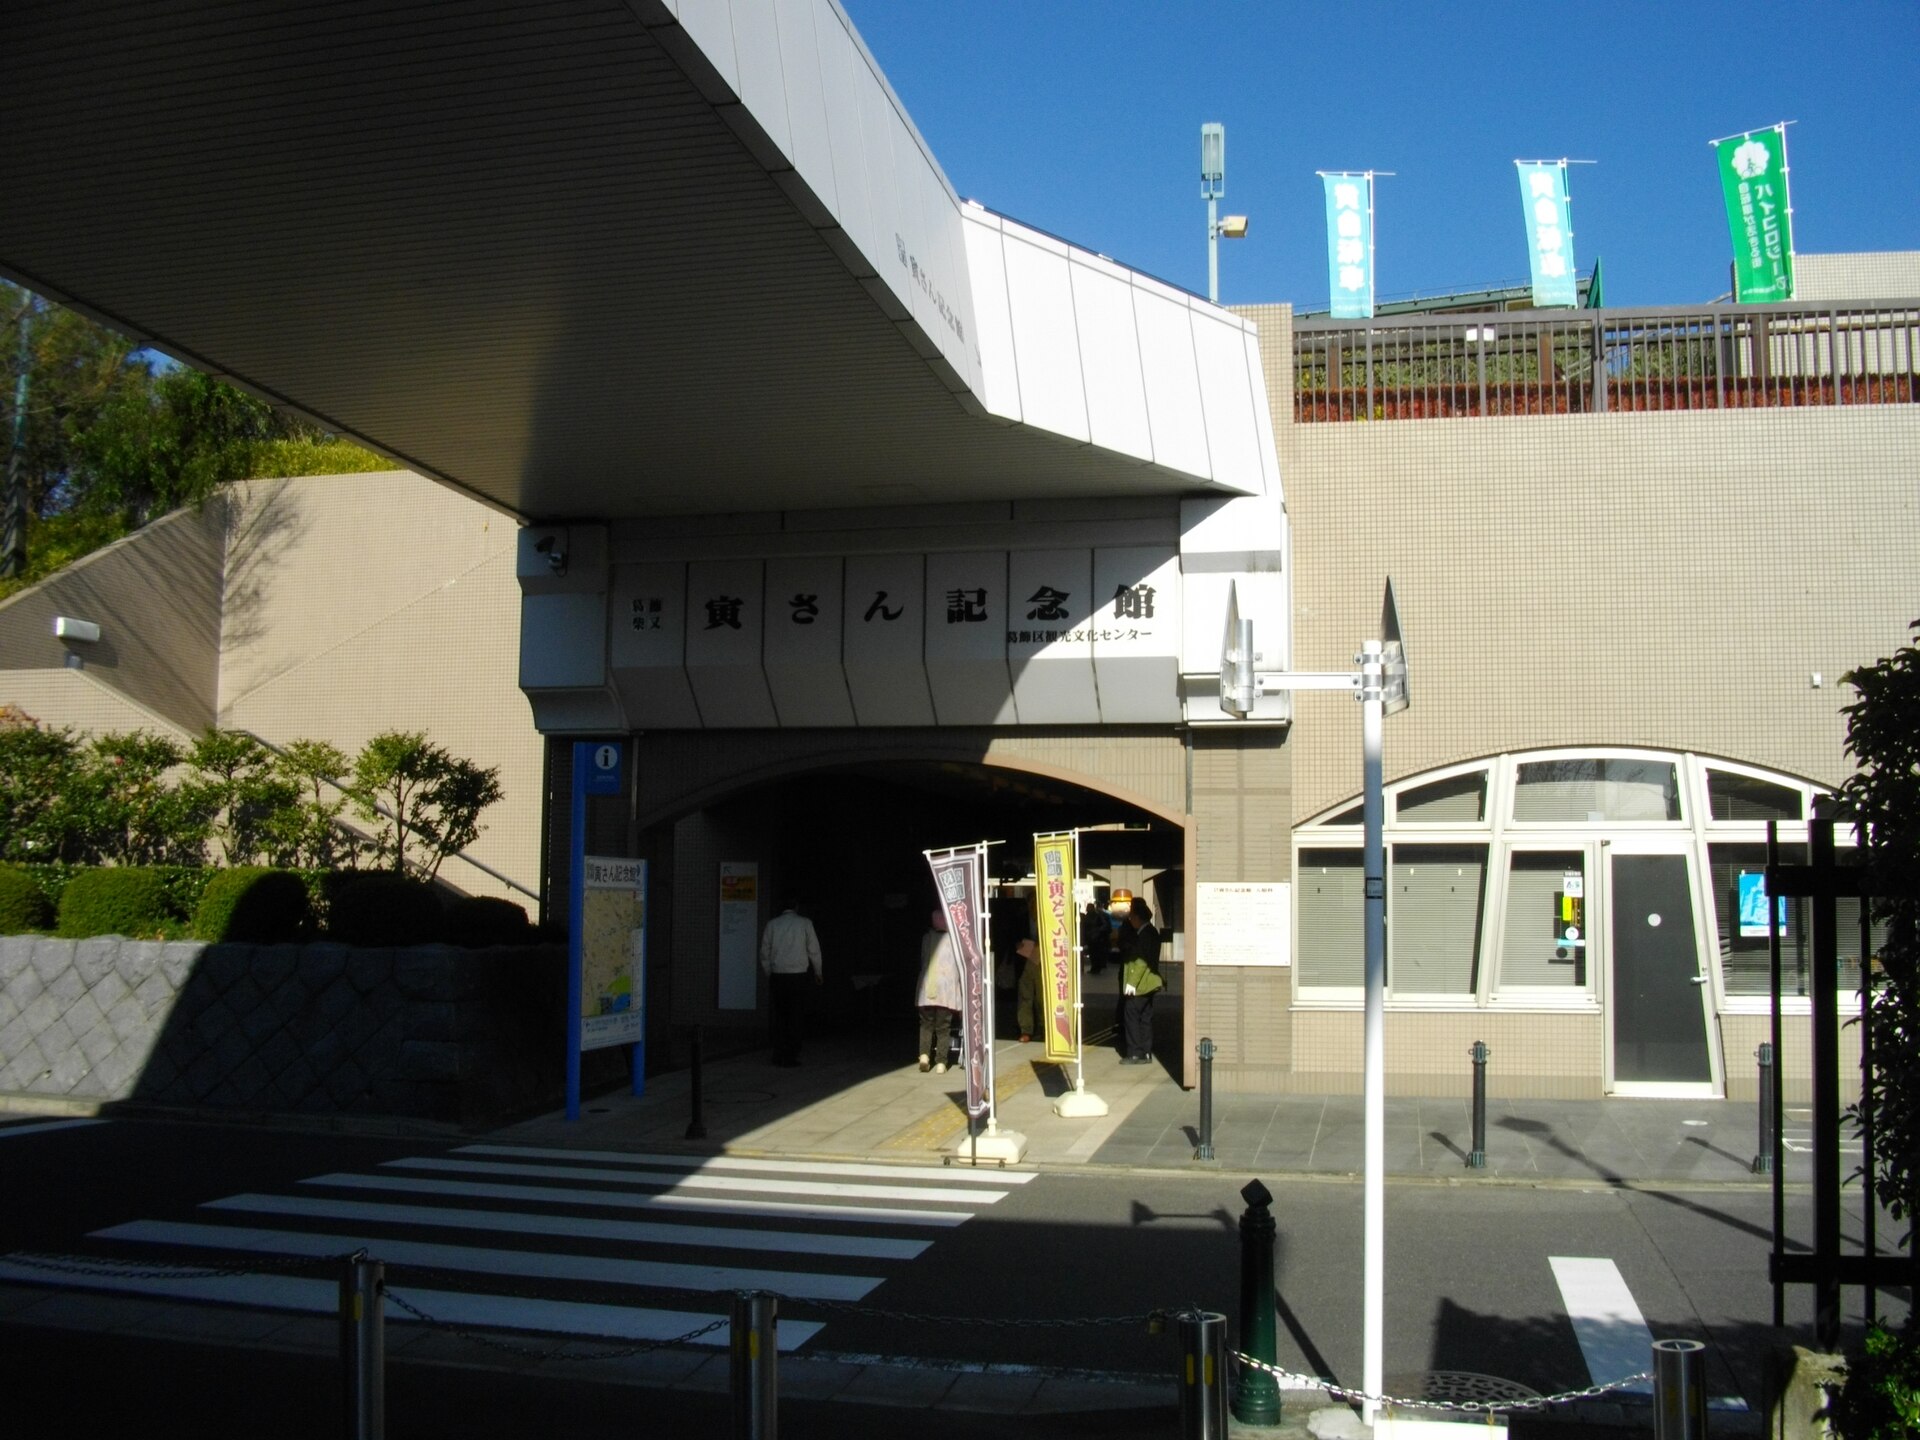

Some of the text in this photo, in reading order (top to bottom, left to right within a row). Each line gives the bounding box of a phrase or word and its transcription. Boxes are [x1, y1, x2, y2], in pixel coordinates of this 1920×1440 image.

[704, 584, 1156, 632] 寅さん記念館
[1007, 629, 1152, 644] 葛飾区観光文化センター
